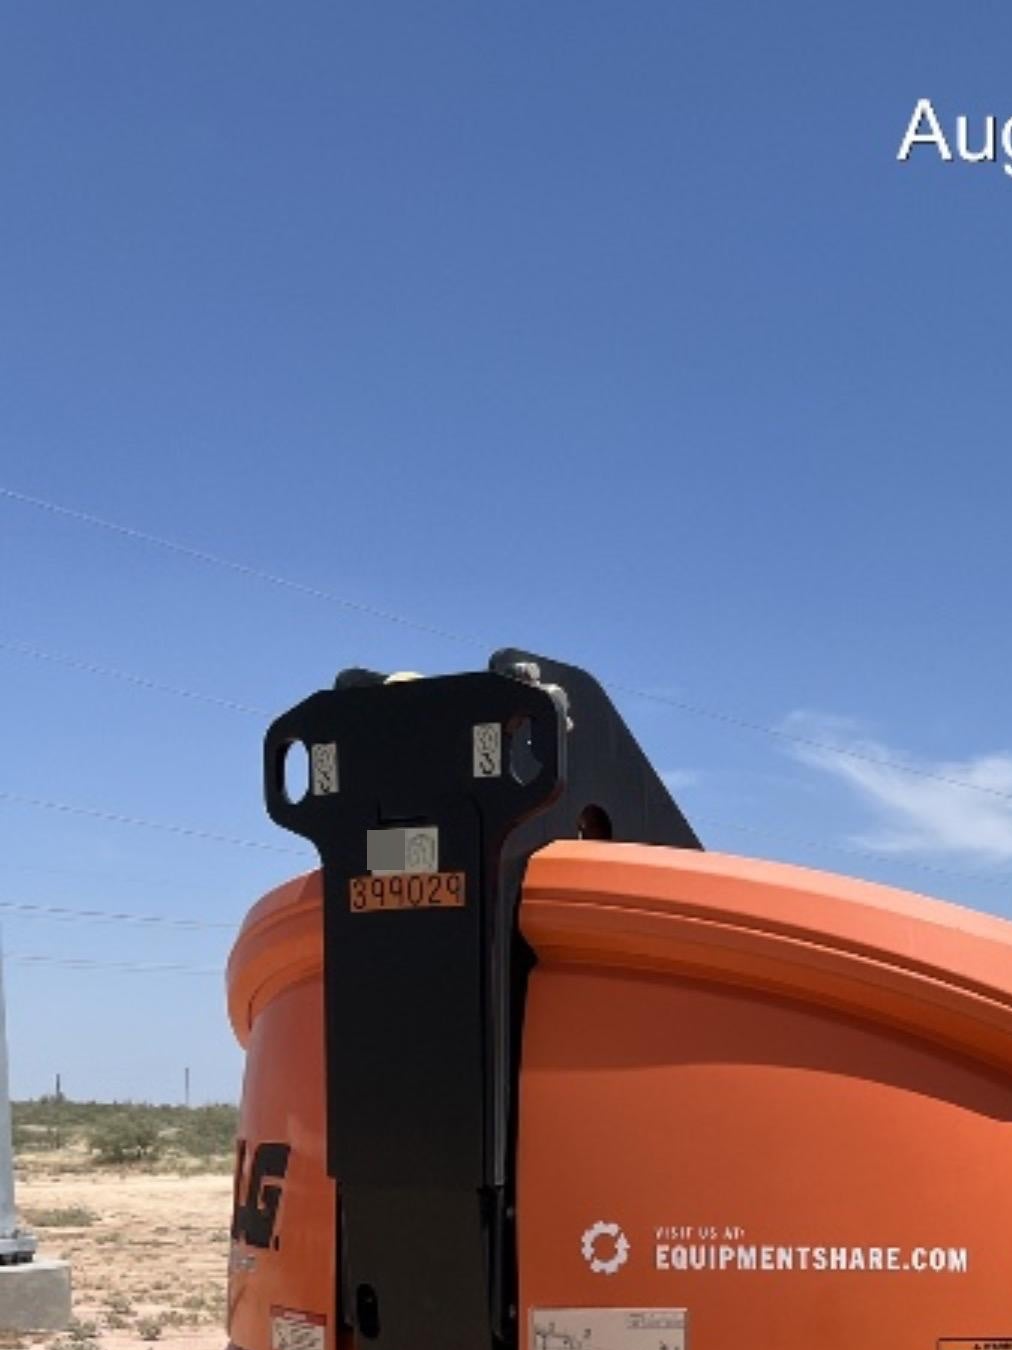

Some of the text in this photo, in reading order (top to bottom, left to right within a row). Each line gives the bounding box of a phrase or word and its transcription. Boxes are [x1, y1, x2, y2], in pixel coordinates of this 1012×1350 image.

[352, 875, 463, 910] 399029
[655, 1226, 693, 1240] VISIT
[698, 1226, 718, 1240] US
[655, 1244, 968, 1273] EQUIPMENTSHARE.COM
